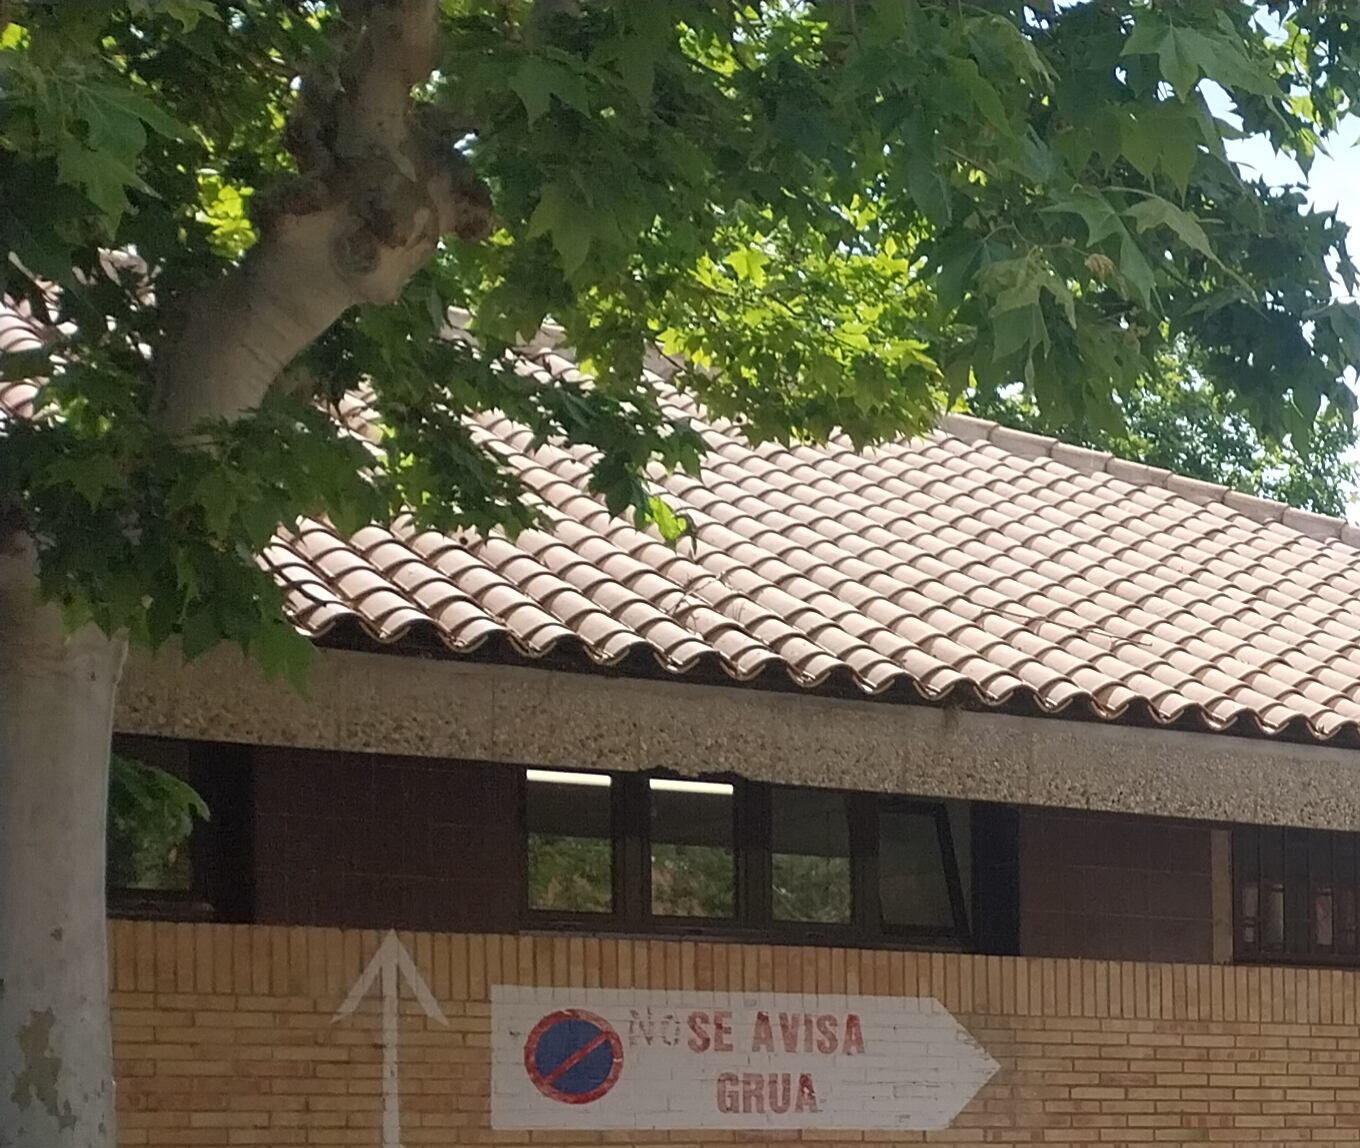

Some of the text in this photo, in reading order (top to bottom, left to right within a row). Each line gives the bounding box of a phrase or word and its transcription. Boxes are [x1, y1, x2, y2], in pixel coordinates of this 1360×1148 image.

[686, 1010, 733, 1052] SE
[752, 1011, 865, 1054] AVISA
[716, 1072, 820, 1114] GRUA
